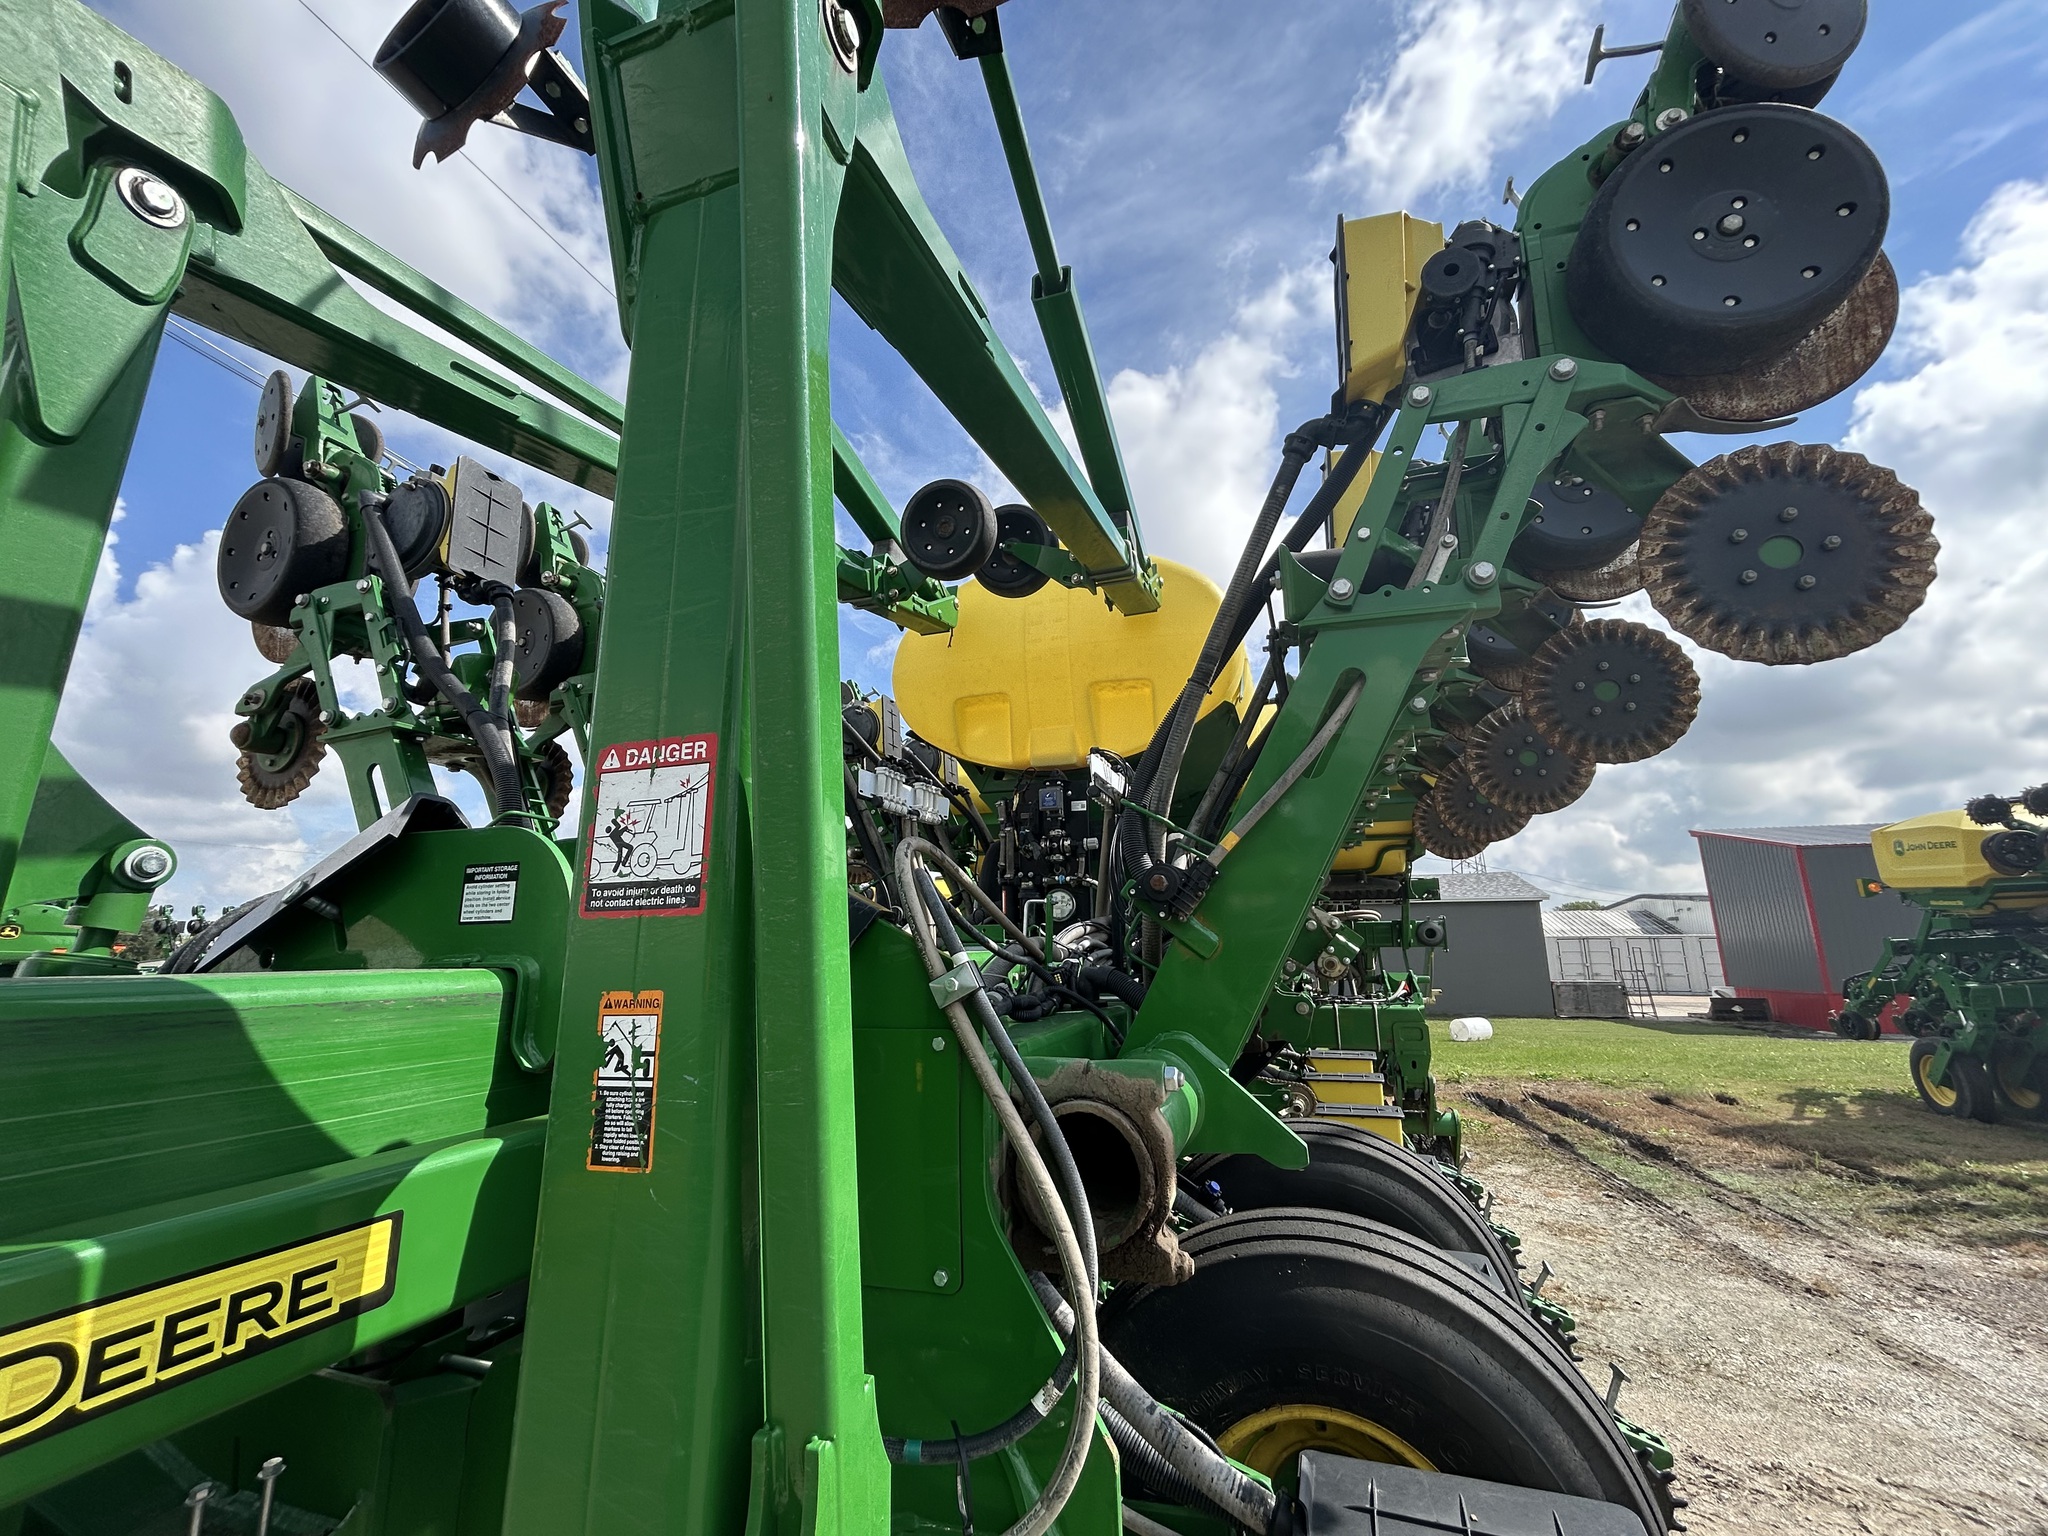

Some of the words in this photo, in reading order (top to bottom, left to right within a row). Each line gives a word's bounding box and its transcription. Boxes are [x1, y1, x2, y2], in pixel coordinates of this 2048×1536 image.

[625, 740, 707, 767] DANGER
[1906, 843, 1927, 851] JOHN
[1927, 841, 1957, 850] DEERE
[592, 888, 602, 897] To
[603, 888, 624, 897] avoid
[661, 885, 683, 894] death
[685, 885, 696, 893] do
[590, 899, 604, 908] not
[604, 898, 634, 907] contact
[634, 896, 664, 906] electric
[666, 896, 686, 905] lines
[614, 998, 660, 1009] WARNING
[0, 1258, 338, 1434] DEERE
[1184, 1363, 1270, 1420] GHWAY
[1296, 1362, 1425, 1418] SERVICE
